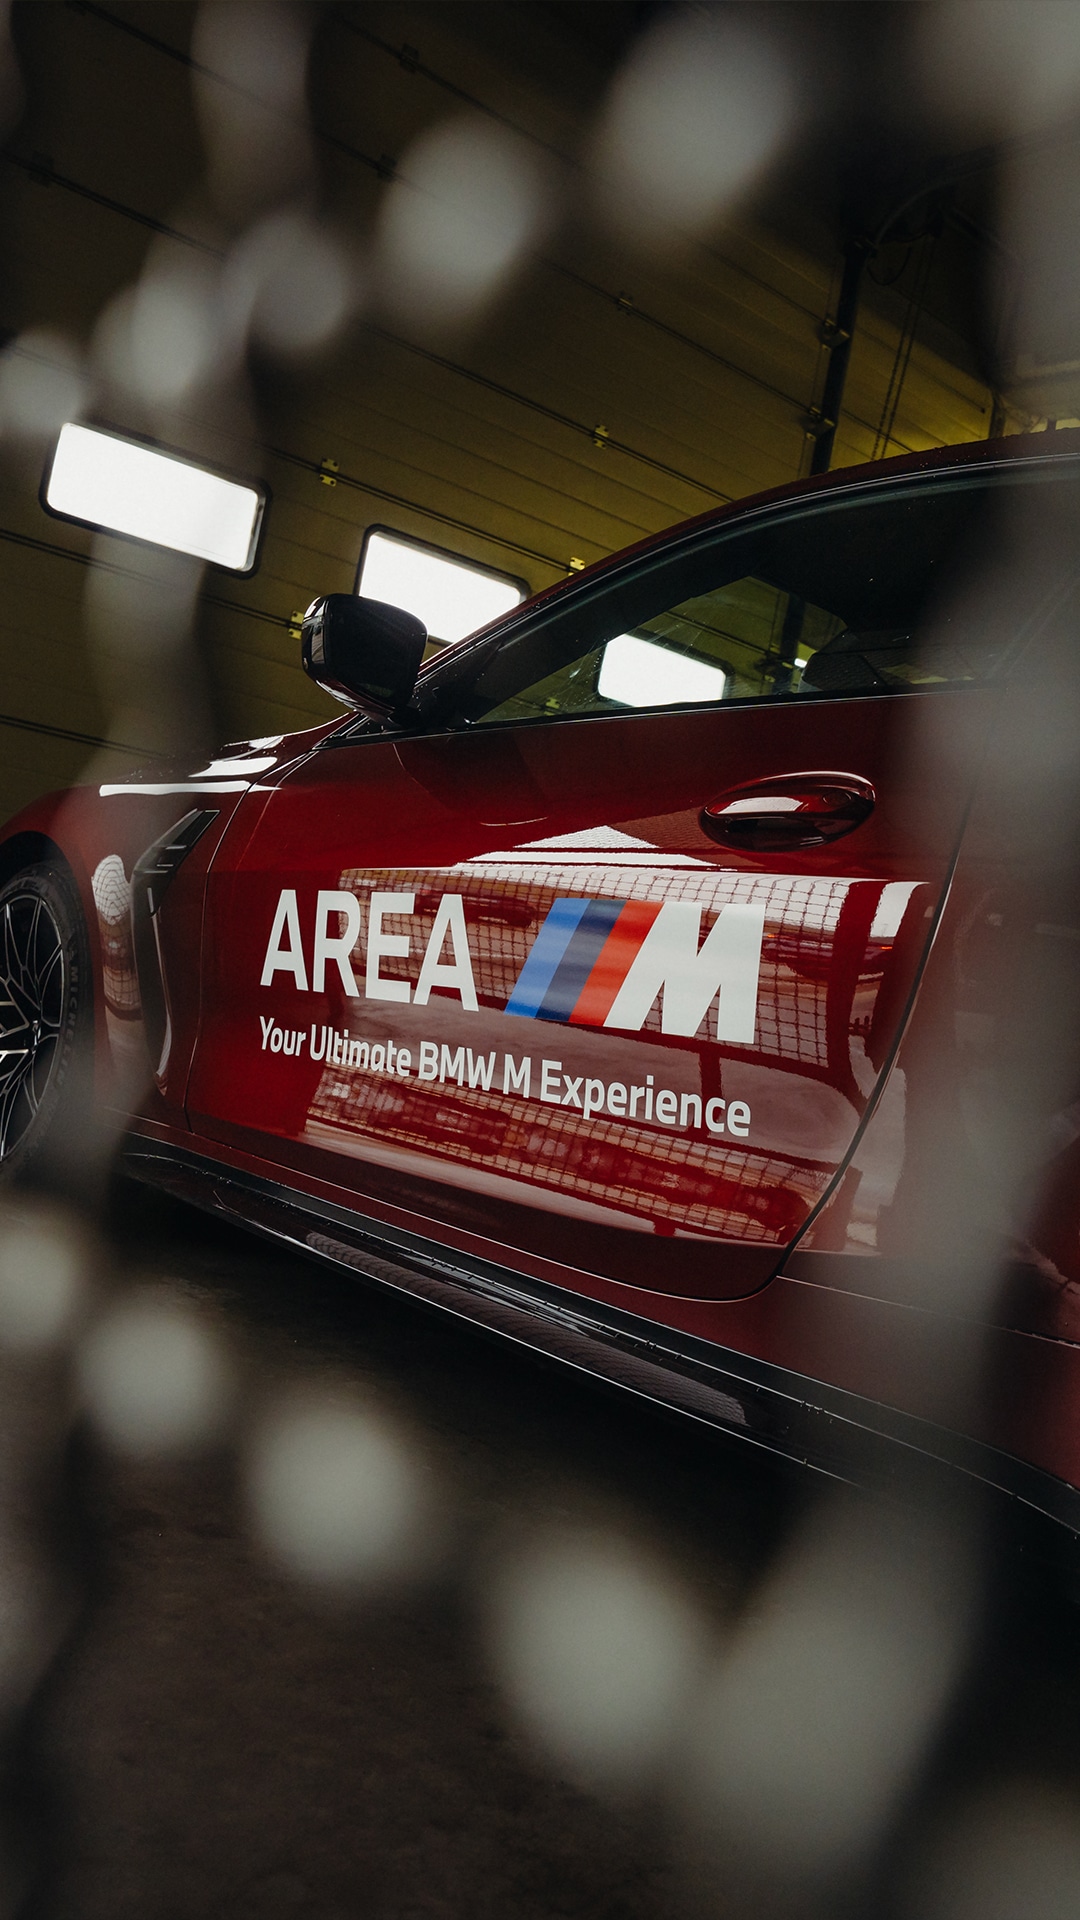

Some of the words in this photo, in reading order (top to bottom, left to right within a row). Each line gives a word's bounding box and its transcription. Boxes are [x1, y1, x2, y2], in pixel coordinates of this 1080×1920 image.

[260, 889, 479, 1012] AREA
[603, 901, 765, 1043] M
[260, 1016, 306, 1056] Your
[309, 1024, 411, 1077] Ultimate
[419, 1042, 496, 1091] BMW
[503, 1053, 531, 1098] M
[540, 1060, 751, 1137] Experience
